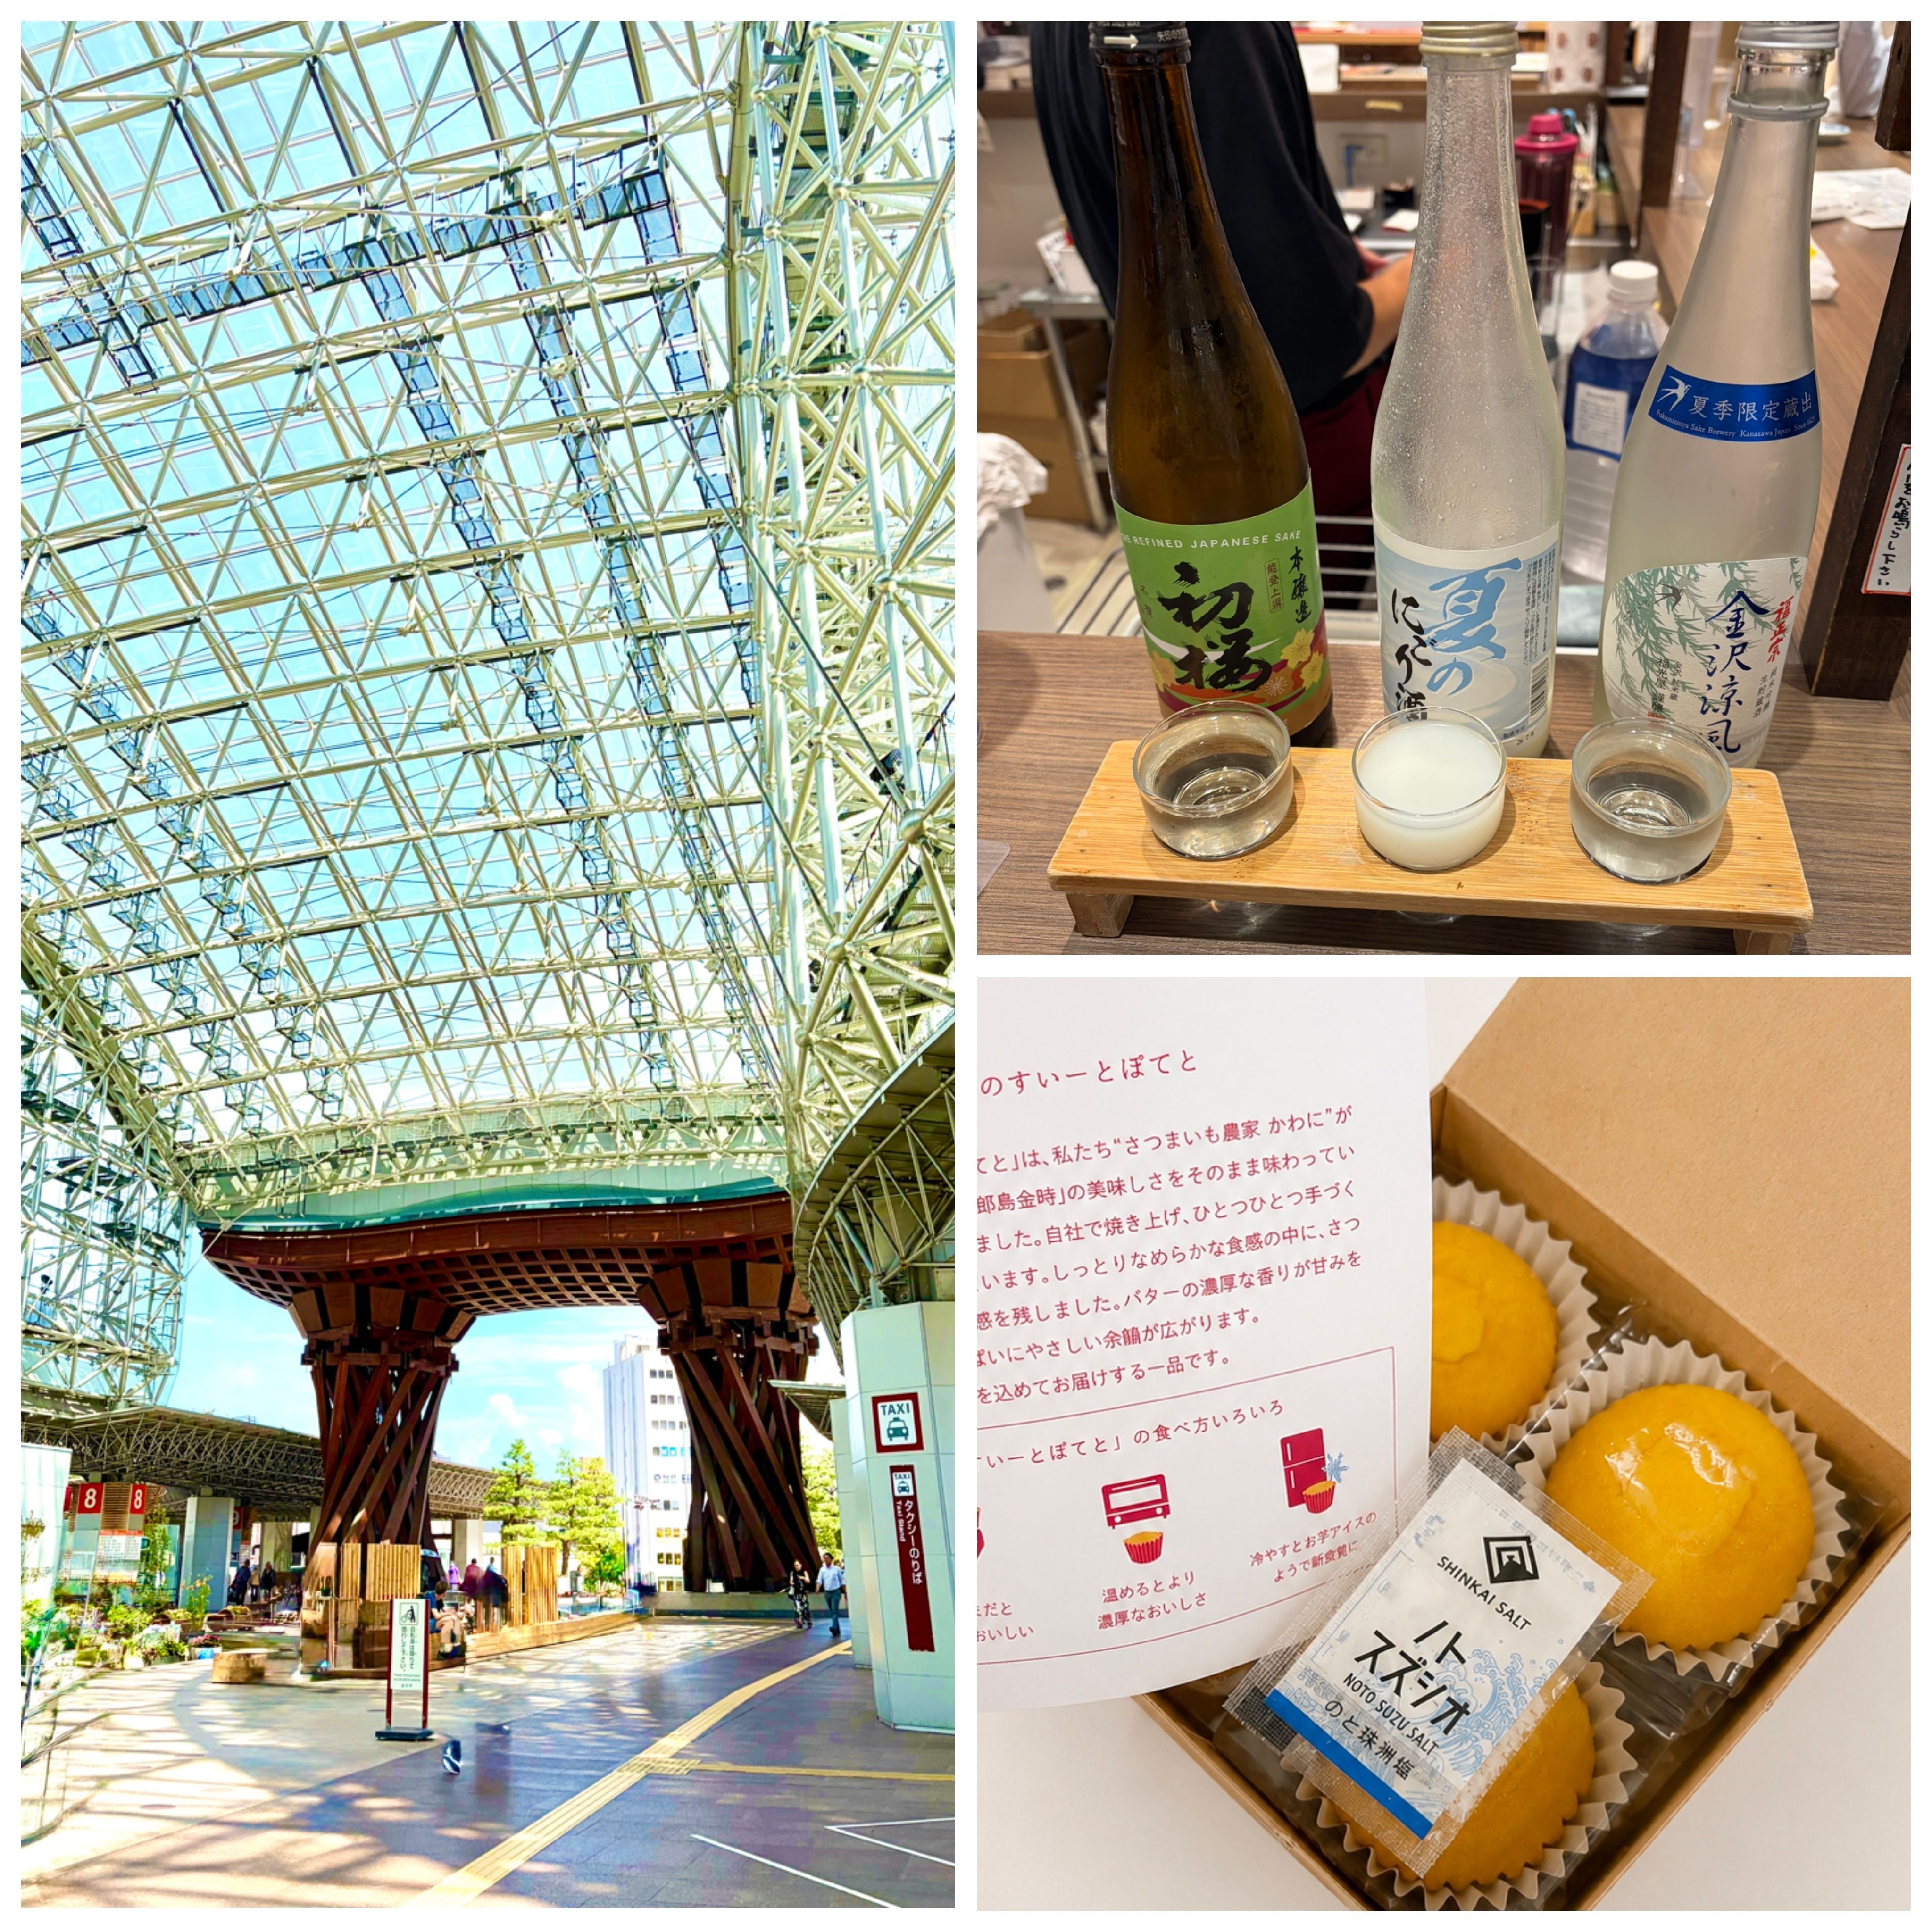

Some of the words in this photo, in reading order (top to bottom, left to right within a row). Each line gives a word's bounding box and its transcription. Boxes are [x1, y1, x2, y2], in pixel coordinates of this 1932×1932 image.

[1656, 409, 1690, 429] Fukumitsuya
[1690, 423, 1706, 433] Sake
[1707, 427, 1736, 438] Brewery
[1740, 429, 1773, 438] Kanazawa
[1774, 427, 1791, 437] Japan
[1689, 392, 1812, 422] 夏季限定蔵出
[1133, 536, 1183, 548] REFINED
[1191, 535, 1269, 548] JAPANESE
[1275, 530, 1301, 542] SAKE
[1423, 557, 1523, 698] 夏の
[1699, 591, 1771, 754] 金沢涼風
[980, 1049, 1197, 1096] のすいーとぽてと
[977, 1180, 1354, 1253] ました。自社で焼き上げ、ひとつひとつ手づく
[977, 1217, 1361, 1292] います。しっとりなめらかな食感の中に、さつ
[977, 1250, 1362, 1331] 感を残しました。バターの濃厚な香りが甘みを
[977, 1349, 1229, 1404] を込めてお届けする一品です。
[880, 1403, 910, 1416] TAXI
[84, 1488, 97, 1509] 8
[134, 1489, 143, 1509] 8
[898, 1518, 906, 1543] Stand
[905, 1500, 923, 1585] タクシーのりば
[1250, 1512, 1377, 1567] 冷やすとお芋アイスの
[977, 1602, 1013, 1617] だと
[1098, 1591, 1208, 1630] 濃厚なおいしさ
[1102, 1571, 1195, 1603] 温めるとより
[1437, 1555, 1496, 1605] SHINKAI
[1495, 1601, 1532, 1631] SALT
[1412, 1620, 1466, 1665] ノト
[1354, 1629, 1471, 1736] スズシオ
[1324, 1699, 1415, 1781] のと珠洲塩
[1343, 1673, 1376, 1704] NOTO
[1375, 1699, 1411, 1731] SUZU
[1407, 1727, 1441, 1756] SALT
